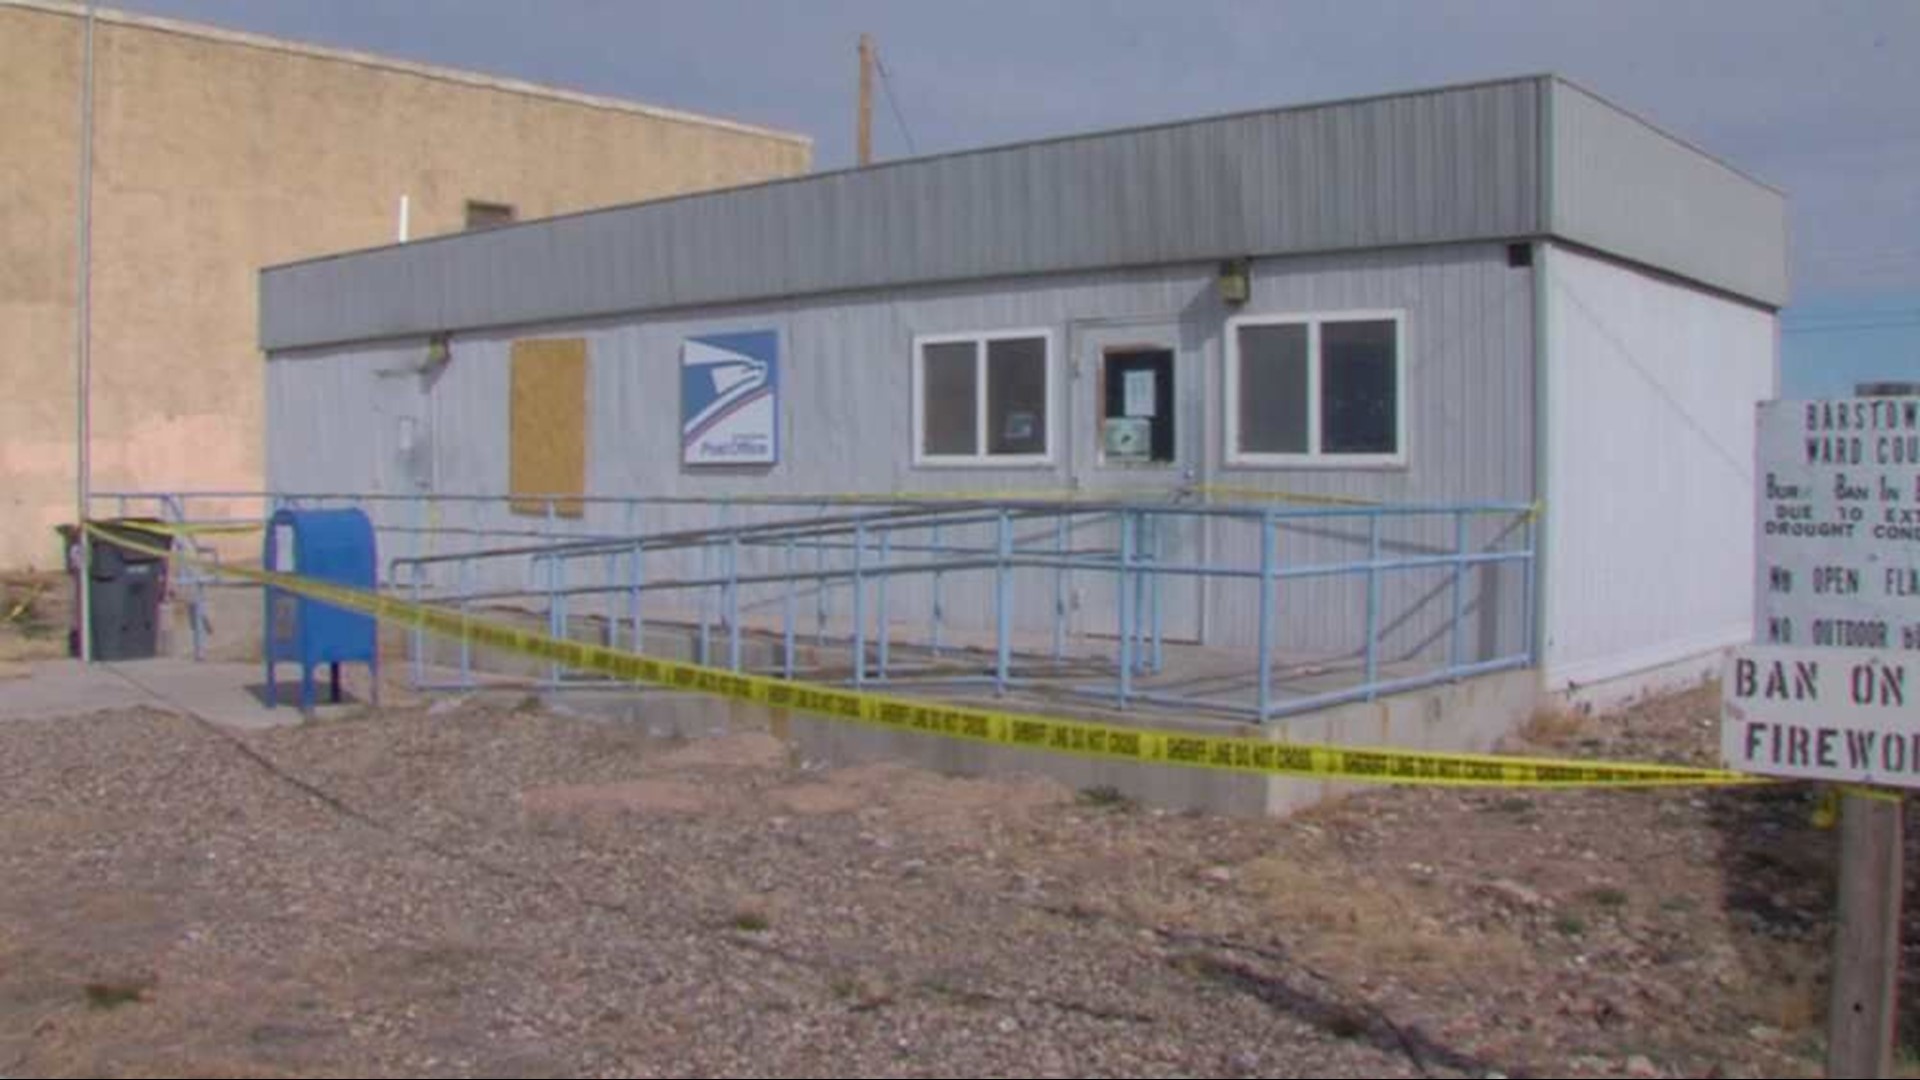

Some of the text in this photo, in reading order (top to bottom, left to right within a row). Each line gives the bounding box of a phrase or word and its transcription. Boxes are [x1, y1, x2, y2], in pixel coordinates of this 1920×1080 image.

[1806, 401, 1918, 430] BARSTOW
[1806, 436, 1862, 464] WARD
[1776, 505, 1812, 519] DUE
[1838, 506, 1863, 521] TO
[1765, 521, 1855, 537] DROUGHT
[1813, 566, 1859, 595] OPEN
[1769, 617, 1792, 644] NO
[1812, 618, 1888, 648] OUTDOOR
[1736, 659, 1904, 707] BAN ON
